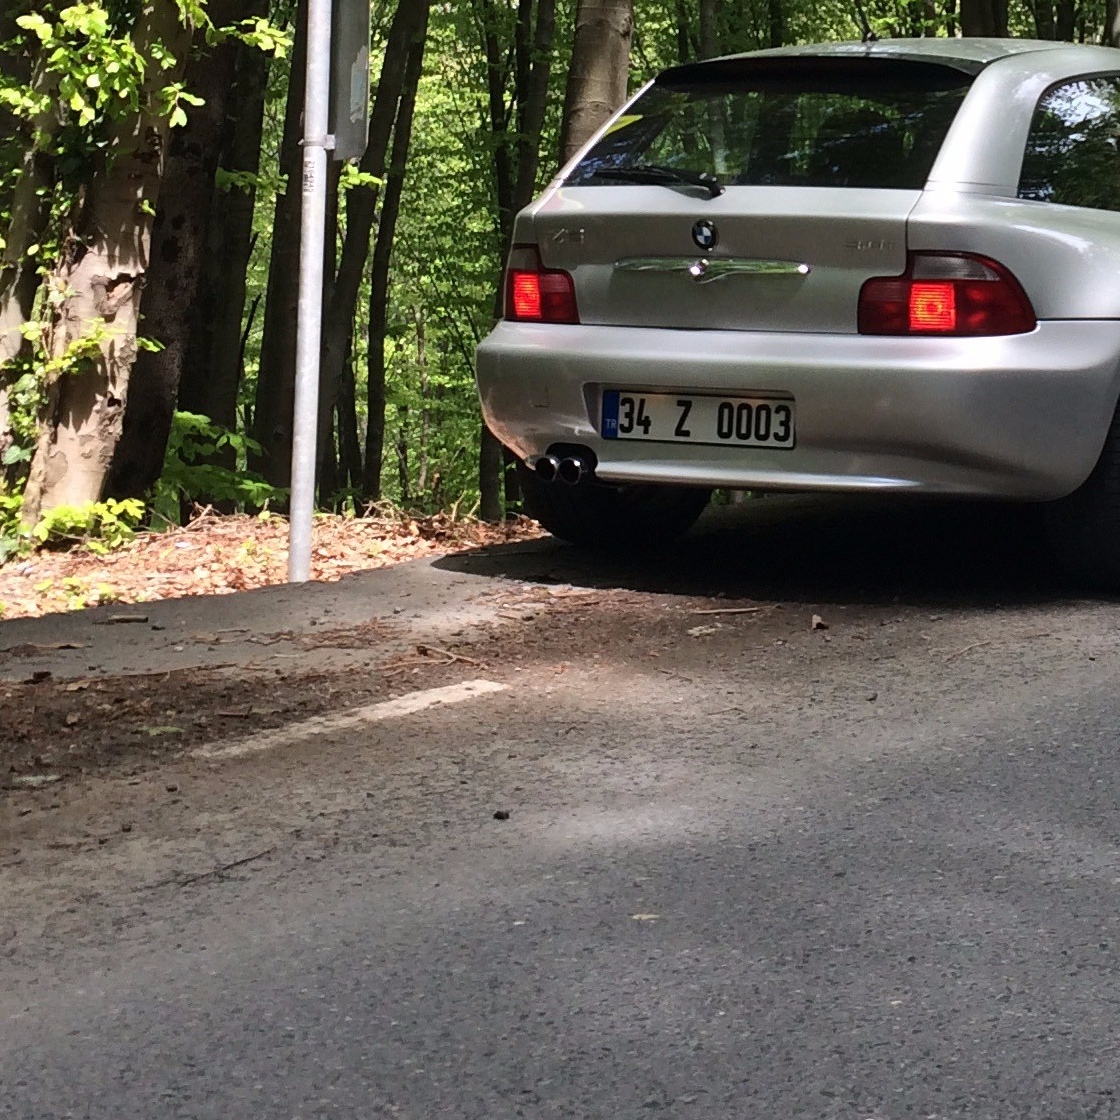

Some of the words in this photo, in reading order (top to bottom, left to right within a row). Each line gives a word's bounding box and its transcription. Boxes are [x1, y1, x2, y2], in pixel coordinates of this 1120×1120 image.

[605, 418, 618, 429] TR
[619, 397, 651, 435] 34
[674, 400, 692, 437] Z
[717, 402, 792, 442] 0003
